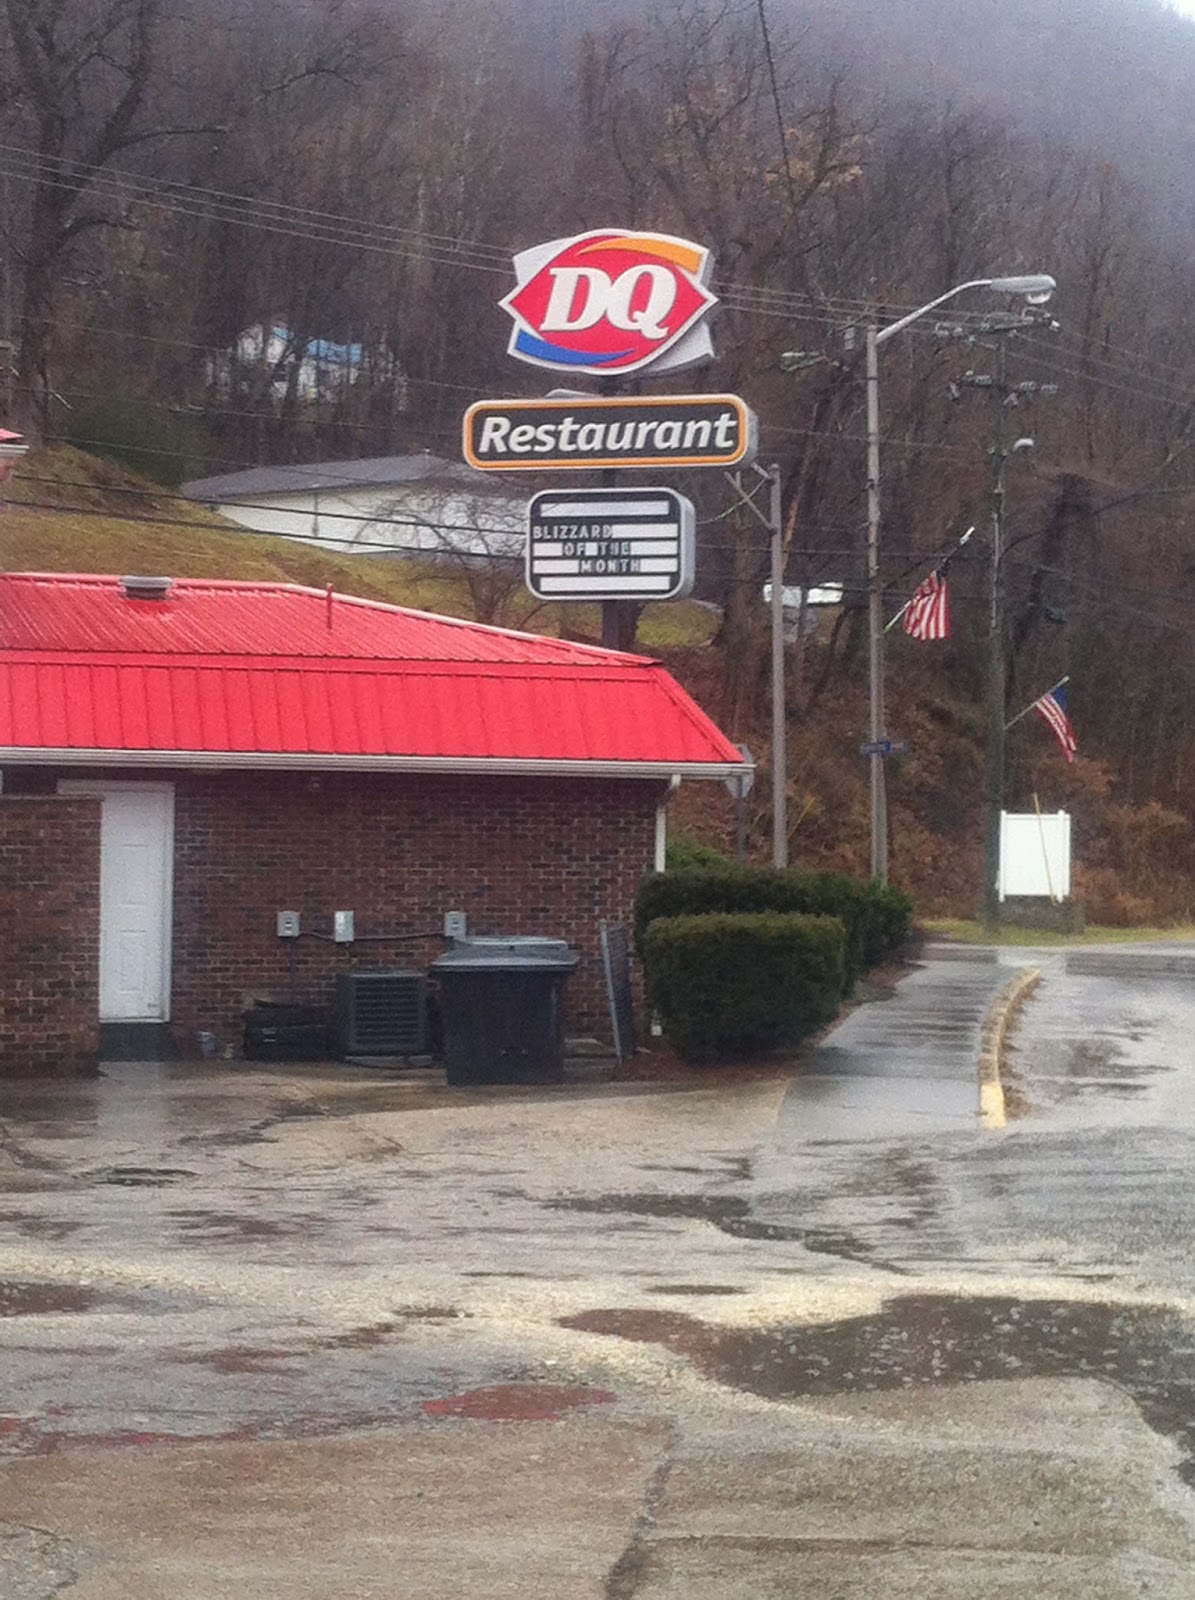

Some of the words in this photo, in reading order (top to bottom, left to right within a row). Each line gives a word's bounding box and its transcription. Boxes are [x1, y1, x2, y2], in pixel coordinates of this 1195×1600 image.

[539, 264, 678, 341] DQ
[478, 412, 738, 453] Restaurant
[532, 524, 613, 539] BLIZZARD
[564, 542, 586, 556] OF
[597, 541, 631, 555] THE
[580, 559, 641, 573] MONTH
